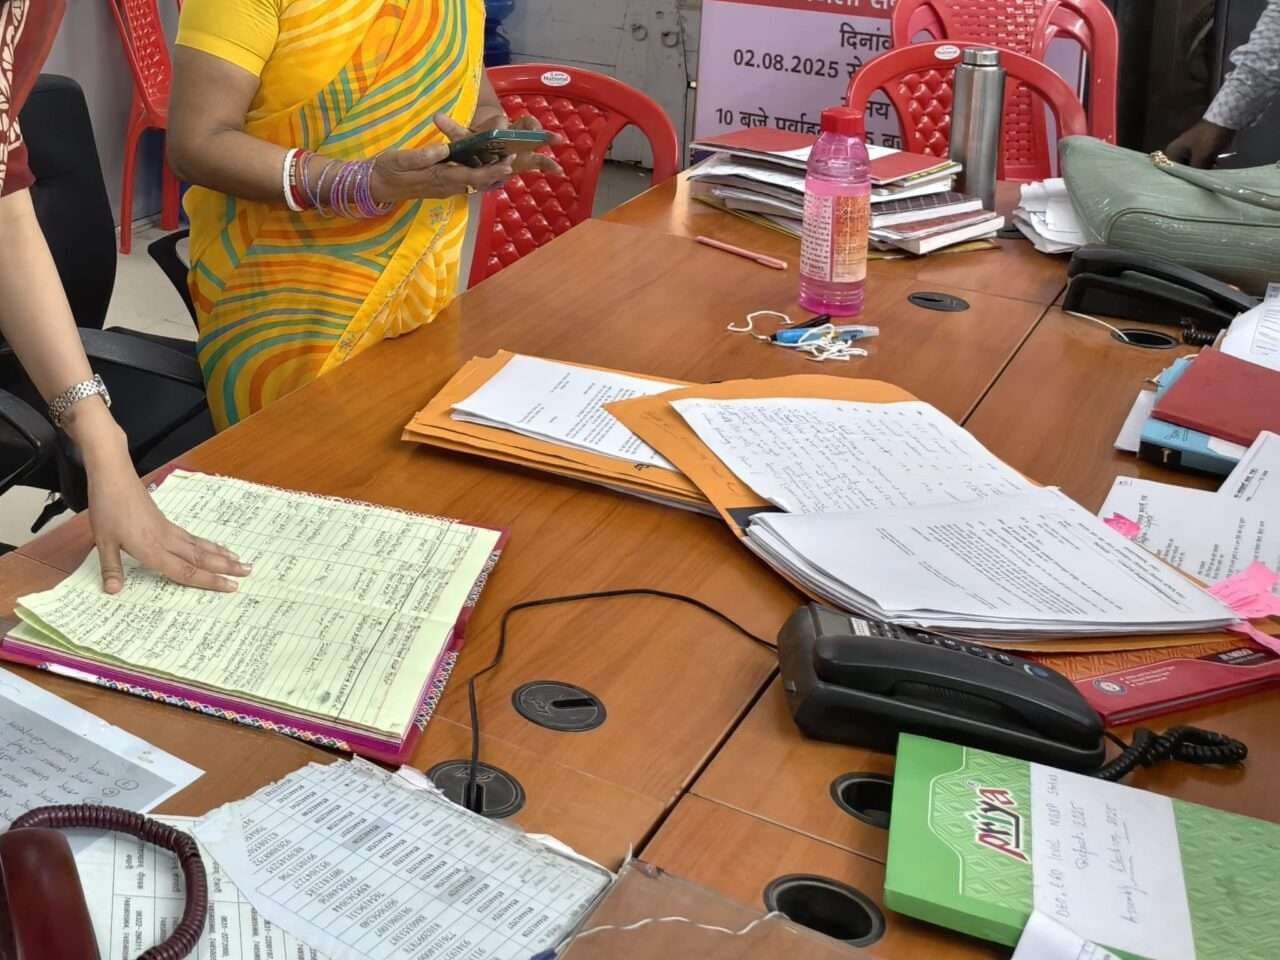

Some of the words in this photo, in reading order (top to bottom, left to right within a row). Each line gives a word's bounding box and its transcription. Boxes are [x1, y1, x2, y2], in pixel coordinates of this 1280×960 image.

[733, 48, 839, 79] 02.08.2025
[715, 107, 734, 126] 10
[967, 787, 1031, 863] priya
